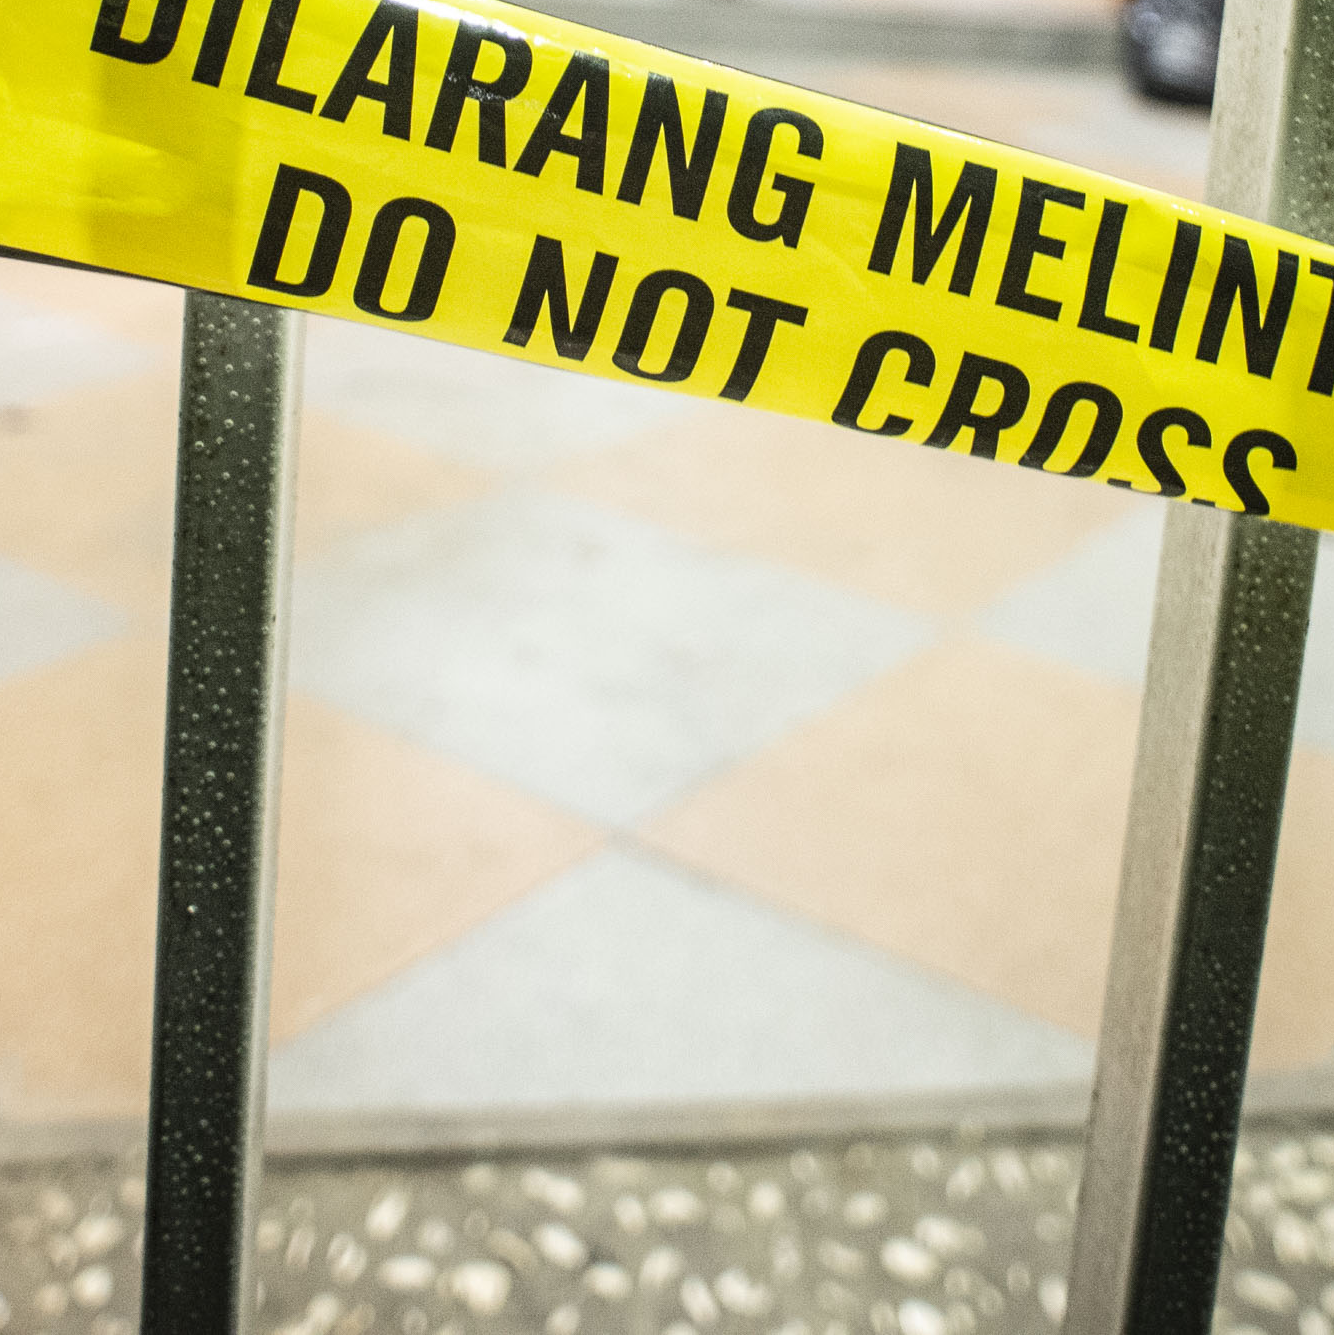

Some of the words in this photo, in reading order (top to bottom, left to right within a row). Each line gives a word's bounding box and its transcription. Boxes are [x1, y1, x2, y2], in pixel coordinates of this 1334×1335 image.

[247, 163, 456, 322] DO
[503, 235, 807, 403] NOT
[831, 330, 1297, 516] CROSS
